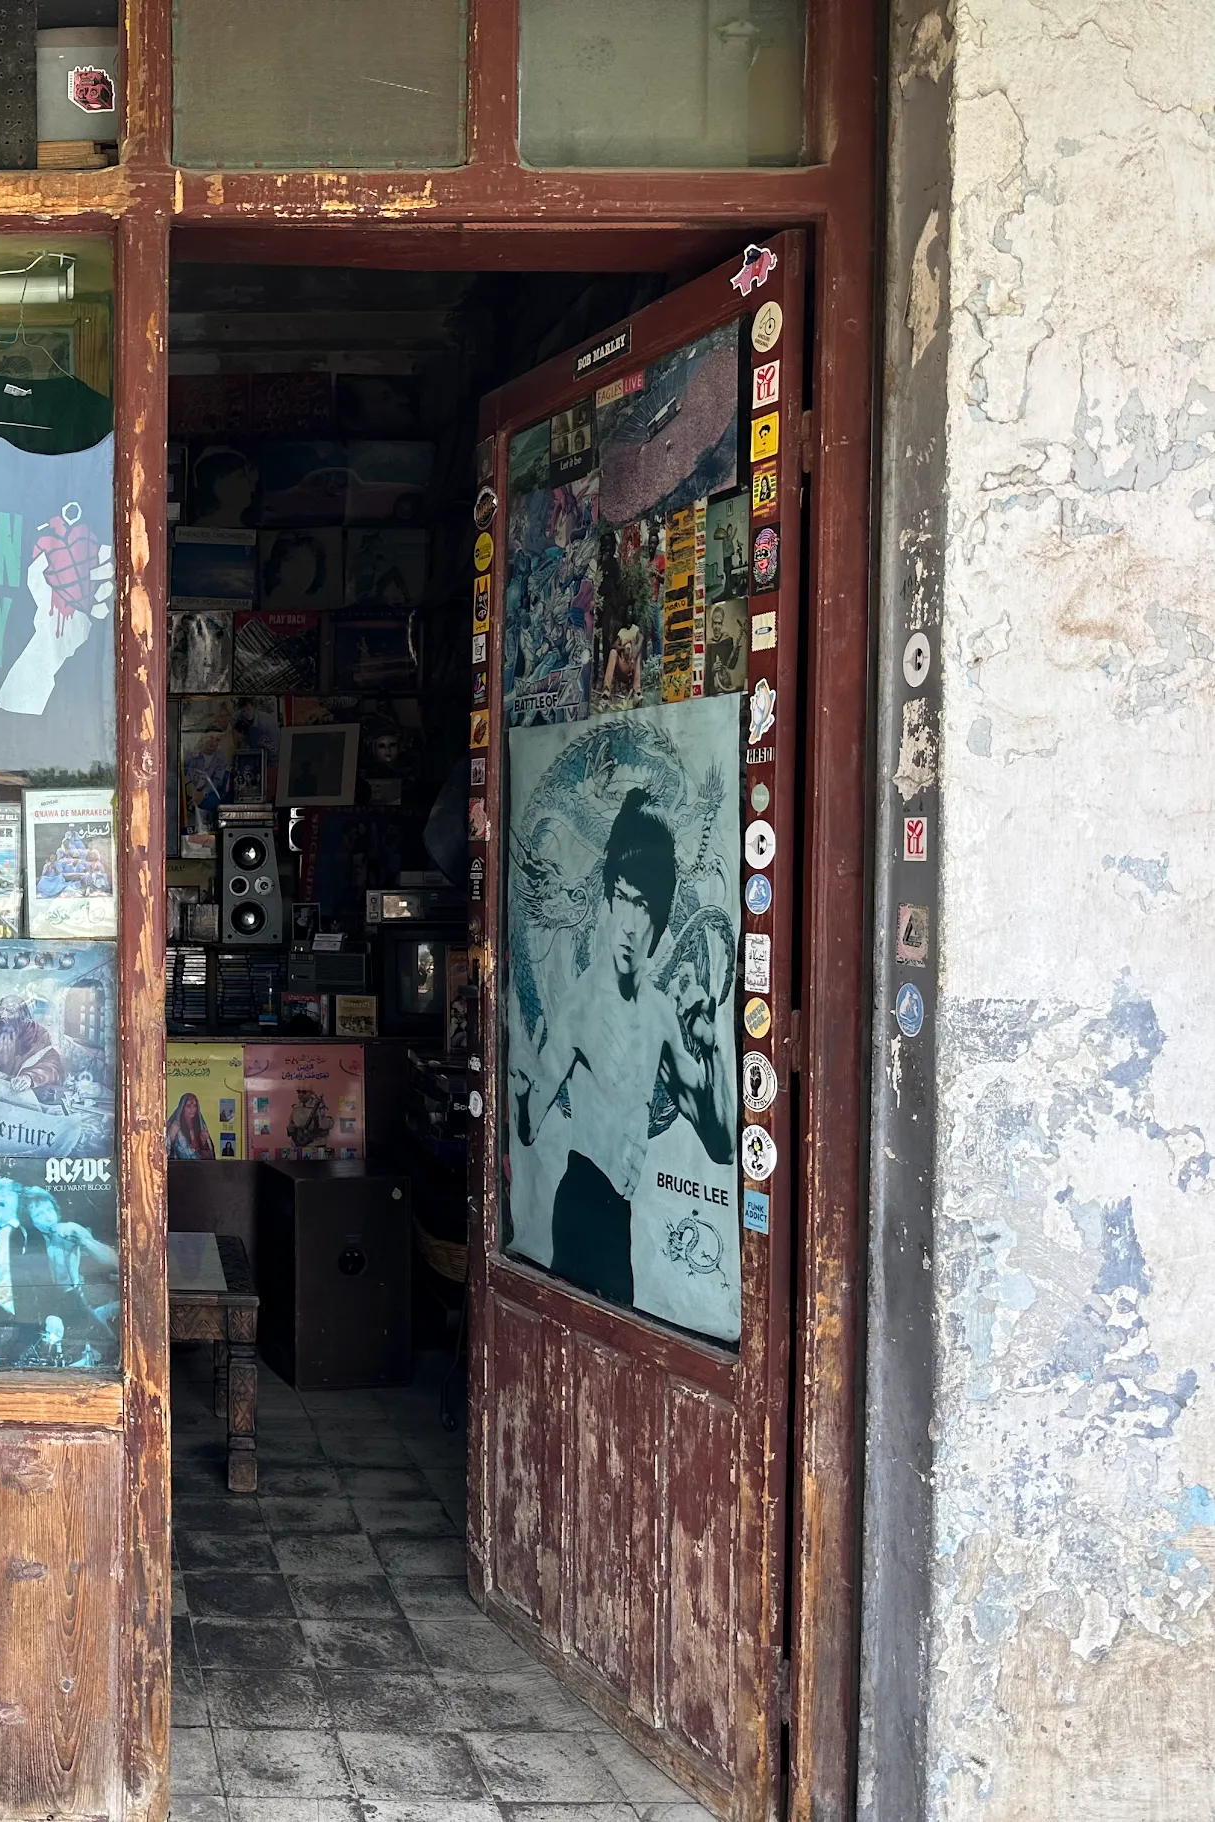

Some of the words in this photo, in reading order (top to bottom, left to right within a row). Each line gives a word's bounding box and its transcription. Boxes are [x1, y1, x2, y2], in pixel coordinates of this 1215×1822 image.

[577, 353, 592, 371] BOB
[593, 333, 626, 363] MARLEY
[597, 382, 623, 405] EAGLES
[624, 374, 644, 392] LIVE
[514, 696, 545, 712] BATTLE
[546, 694, 558, 708] OF
[61, 809, 69, 817] DE
[308, 813, 320, 865] SPICE
[657, 1172, 700, 1199] BRUCE
[704, 1185, 729, 1207] LEE
[745, 1210, 767, 1223] ADDICT
[748, 1202, 764, 1213] FUNK
